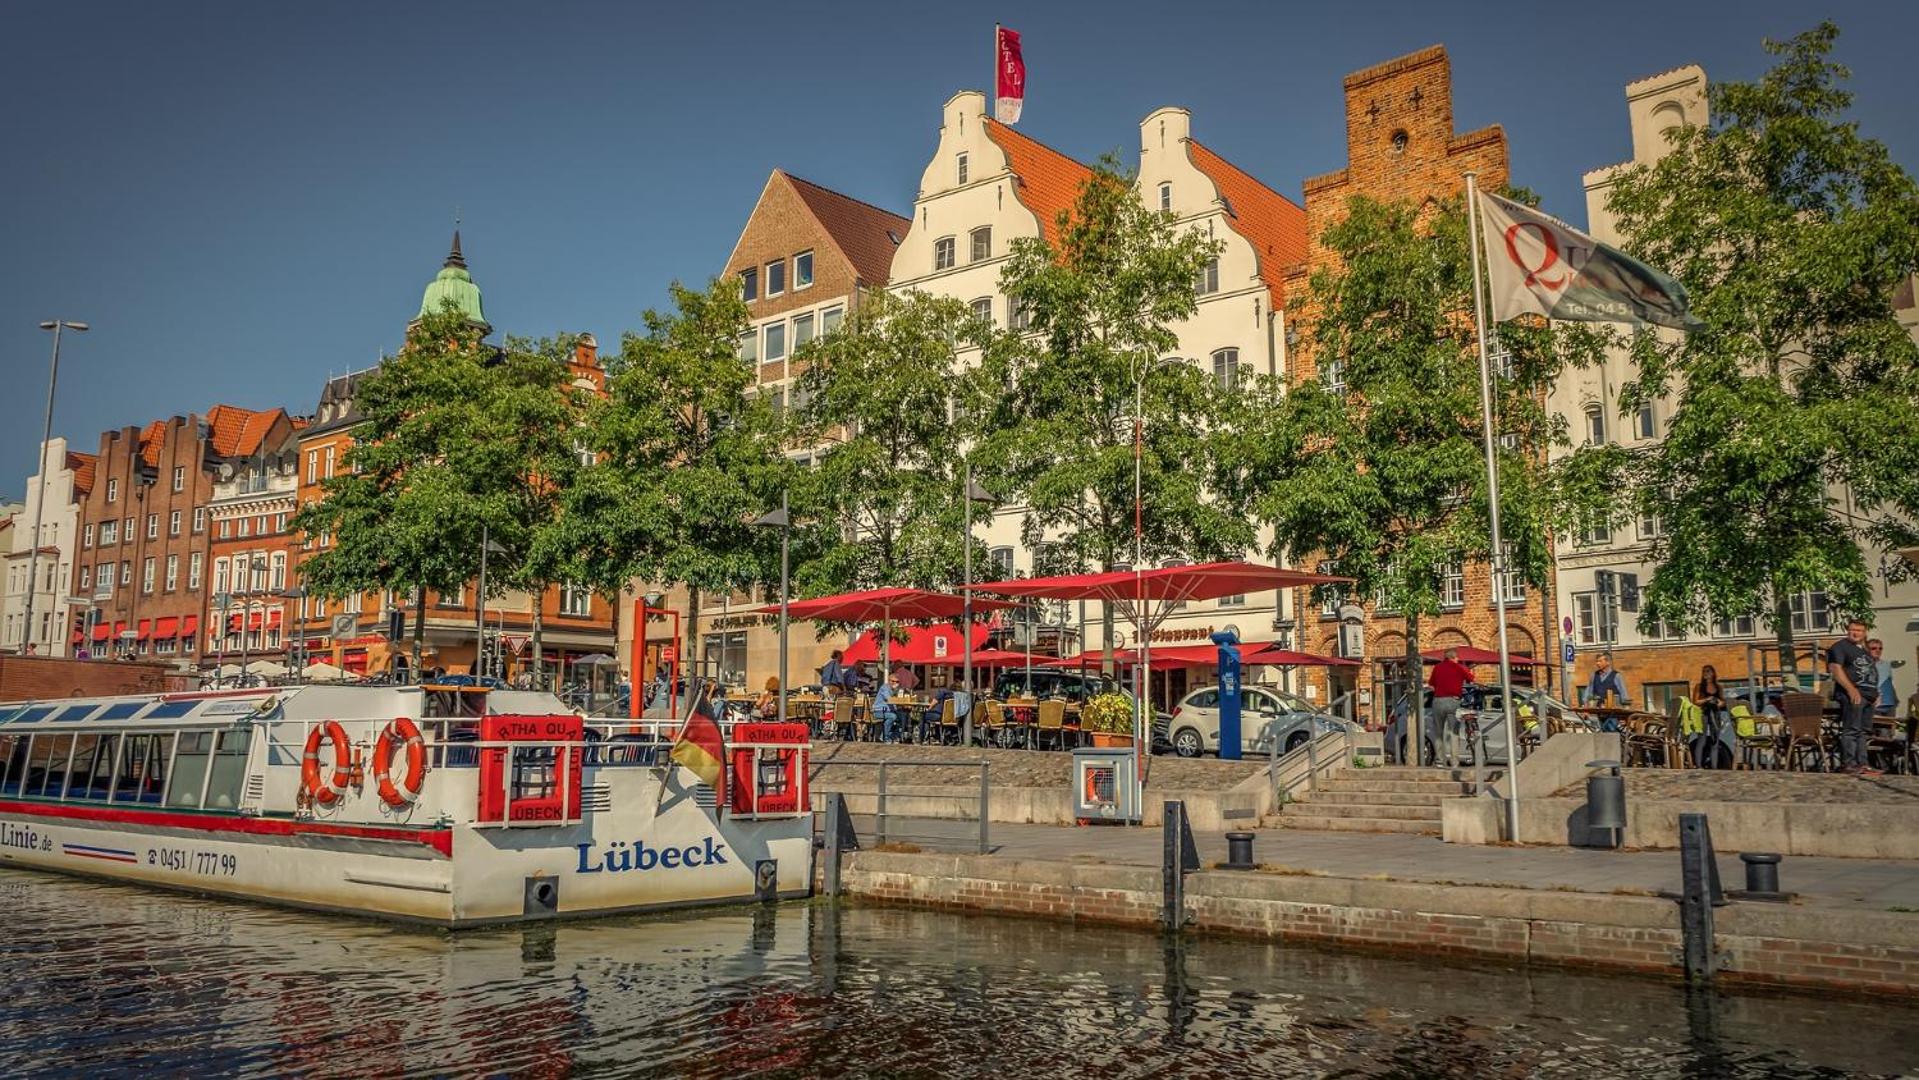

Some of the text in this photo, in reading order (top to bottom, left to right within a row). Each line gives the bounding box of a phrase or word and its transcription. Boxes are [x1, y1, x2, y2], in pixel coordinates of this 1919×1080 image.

[1132, 626, 1214, 643] Rstaurant
[160, 848, 187, 872] 0451
[197, 852, 218, 875] 777
[221, 854, 237, 877] 99
[576, 836, 728, 873] Lübeck
